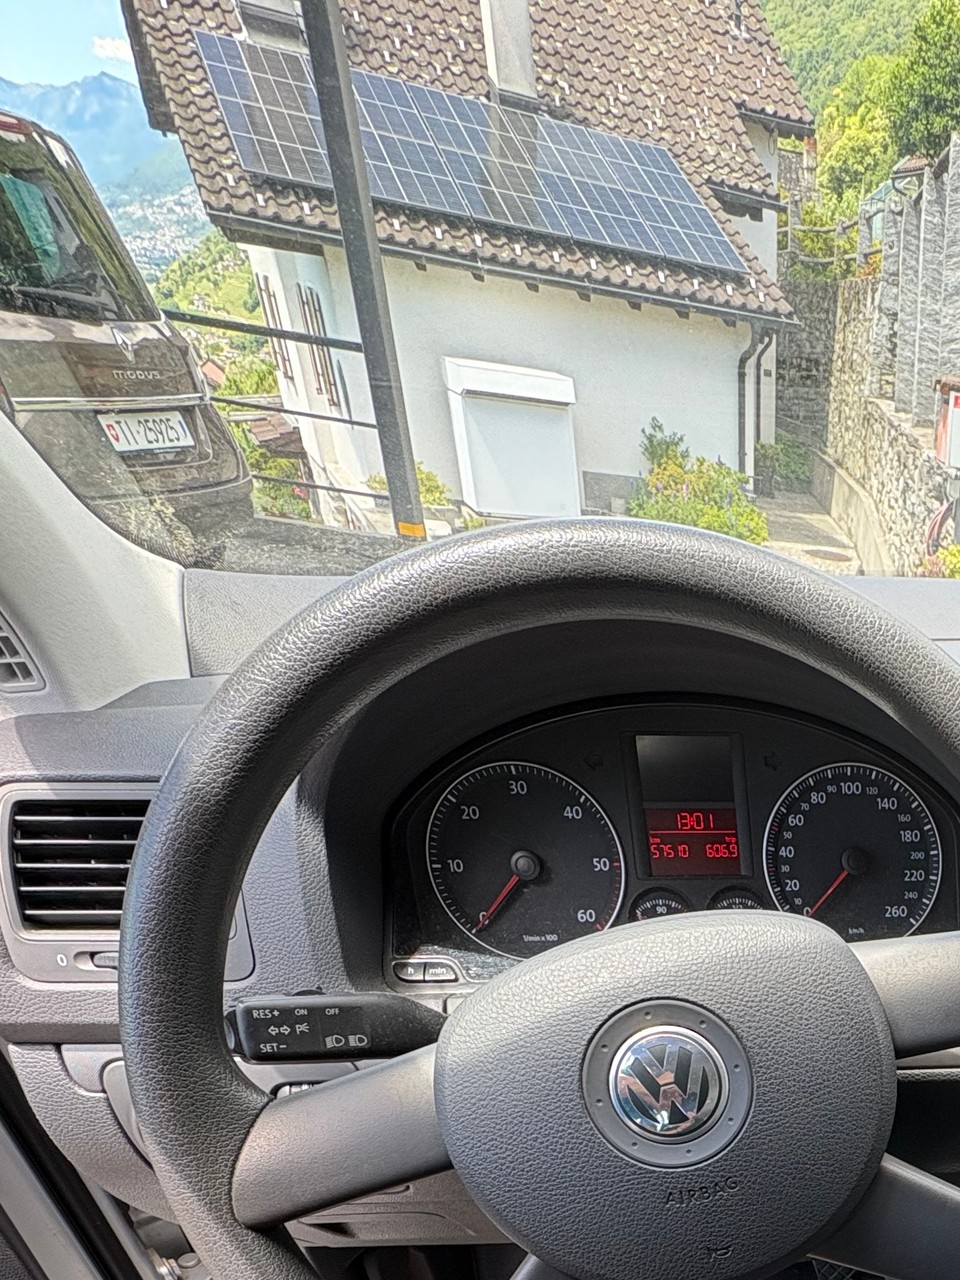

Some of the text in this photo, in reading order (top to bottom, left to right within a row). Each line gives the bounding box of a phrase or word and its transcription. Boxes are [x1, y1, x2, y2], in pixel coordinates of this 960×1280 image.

[508, 780, 527, 795] 30
[827, 785, 837, 793] 90
[840, 782, 862, 795] 100
[866, 787, 878, 795] 120
[810, 792, 826, 804] 80
[877, 797, 898, 810] 140
[460, 805, 480, 820] 20
[563, 805, 582, 820] 40
[800, 803, 810, 811] 70
[677, 812, 714, 830] 13:01
[788, 814, 804, 826] 60
[898, 814, 911, 822] 160
[783, 831, 793, 839] 50
[900, 830, 921, 842] 180
[650, 844, 689, 858] 57510
[779, 846, 794, 857] 40
[910, 851, 925, 860] 200
[447, 859, 464, 873] 10
[592, 858, 610, 872] 50
[780, 864, 790, 873] 30
[904, 869, 925, 882] 220
[784, 879, 800, 892] 20
[794, 897, 802, 906] 10
[904, 891, 918, 900] 240
[577, 909, 596, 923] 60
[655, 906, 668, 914] 90
[884, 906, 908, 918] 260
[408, 967, 415, 975] h
[429, 967, 447, 975] min
[294, 1008, 308, 1016] ON
[325, 1008, 340, 1016] OFF
